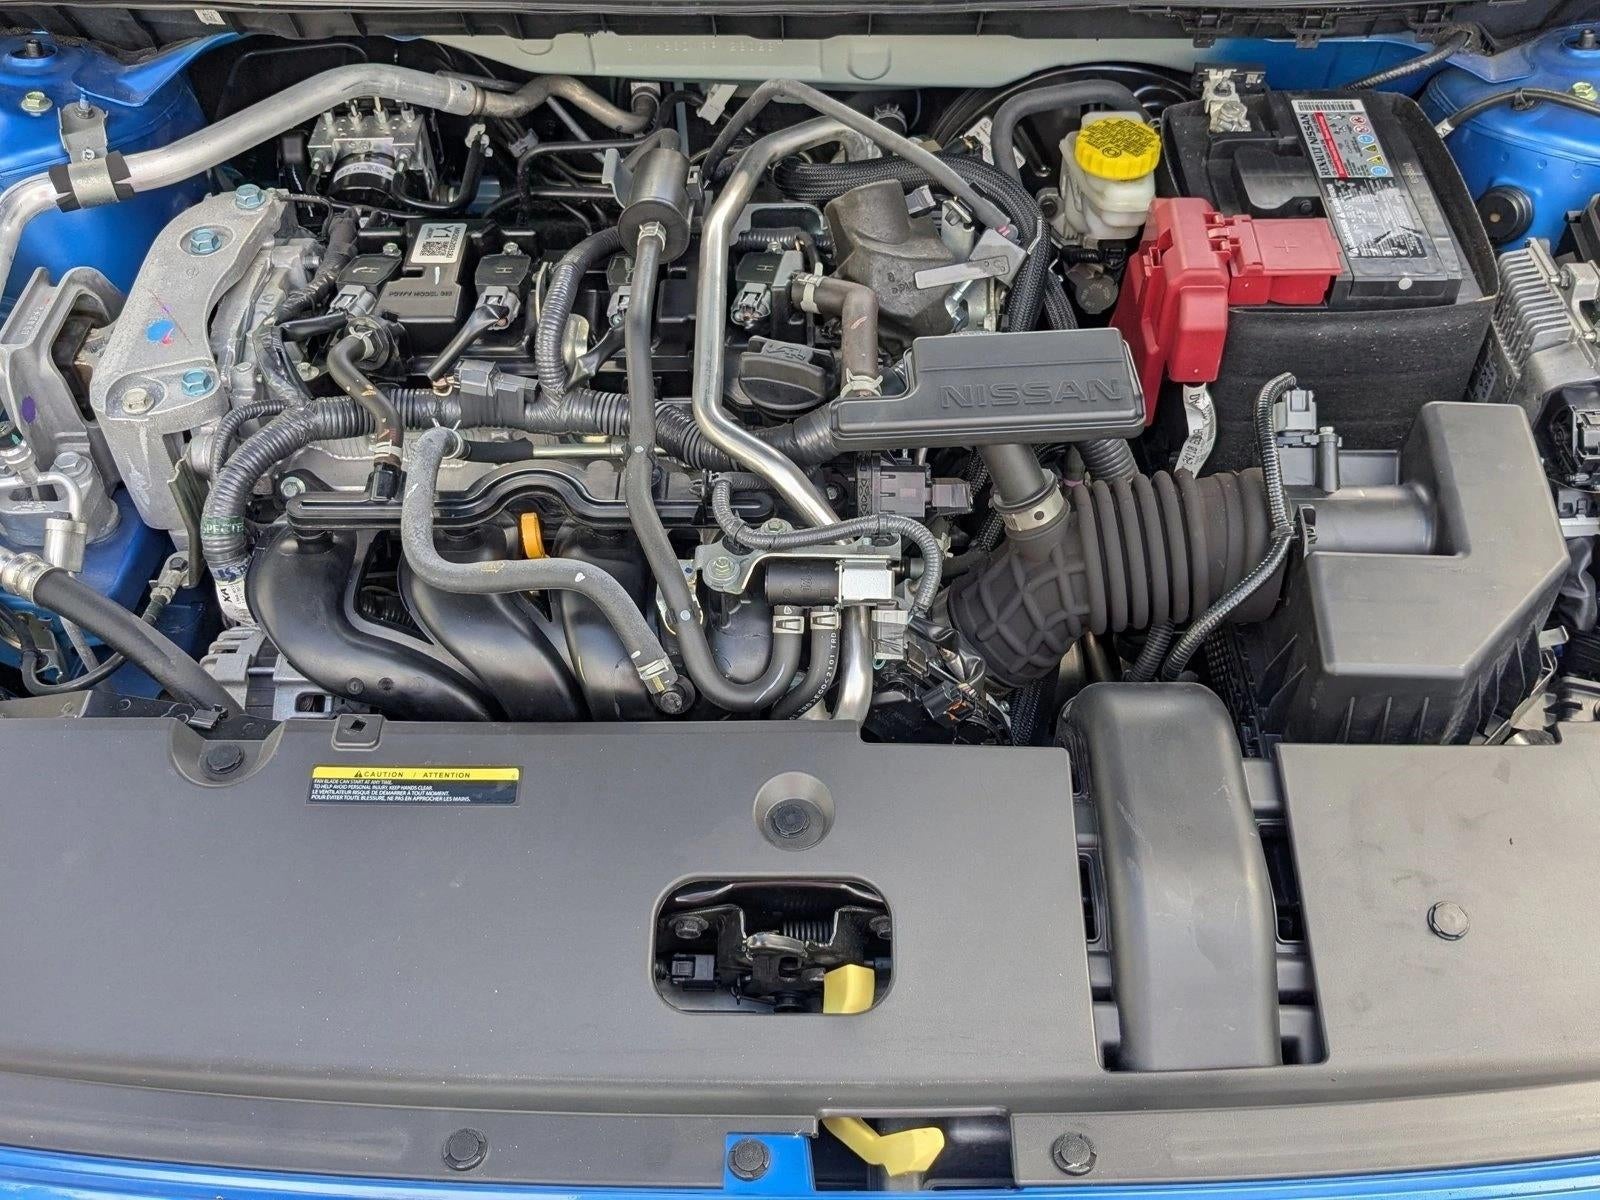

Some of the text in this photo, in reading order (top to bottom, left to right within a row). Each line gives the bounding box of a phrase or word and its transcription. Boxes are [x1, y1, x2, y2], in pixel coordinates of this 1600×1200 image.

[1300, 114, 1318, 144] NISSAN
[1311, 147, 1331, 175] RENAULT
[434, 225, 454, 240] Y1
[939, 378, 1121, 408] NISSAN
